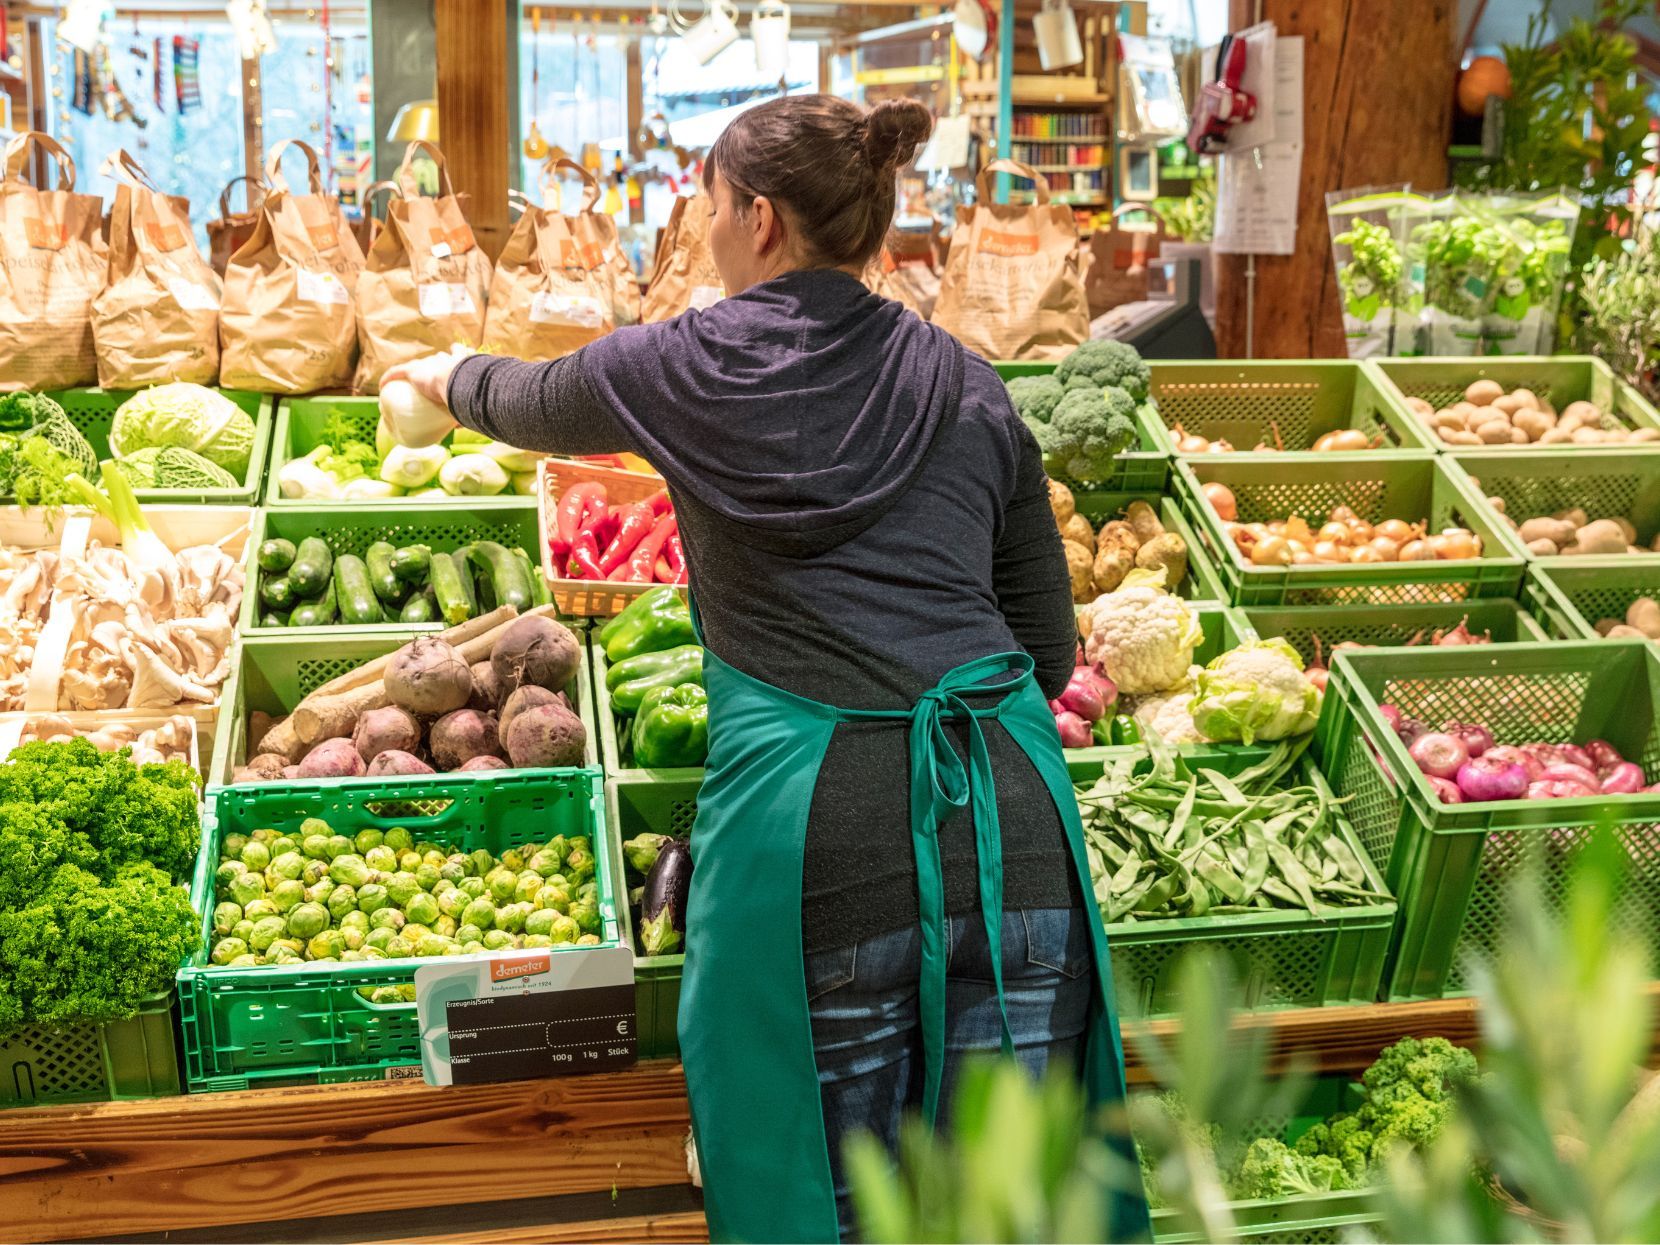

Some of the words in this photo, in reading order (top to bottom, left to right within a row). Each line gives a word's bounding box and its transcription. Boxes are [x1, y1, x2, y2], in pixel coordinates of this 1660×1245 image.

[496, 960, 544, 977] demeter
[538, 980, 552, 988] 1924
[446, 997, 494, 1008] Erzeugnis/Sorte
[616, 1020, 628, 1035] €
[448, 1032, 477, 1040] Ursprung
[583, 1051, 587, 1059] 1
[588, 1050, 598, 1059] kg
[607, 1047, 629, 1056] Stück
[450, 1056, 471, 1065] Klasse
